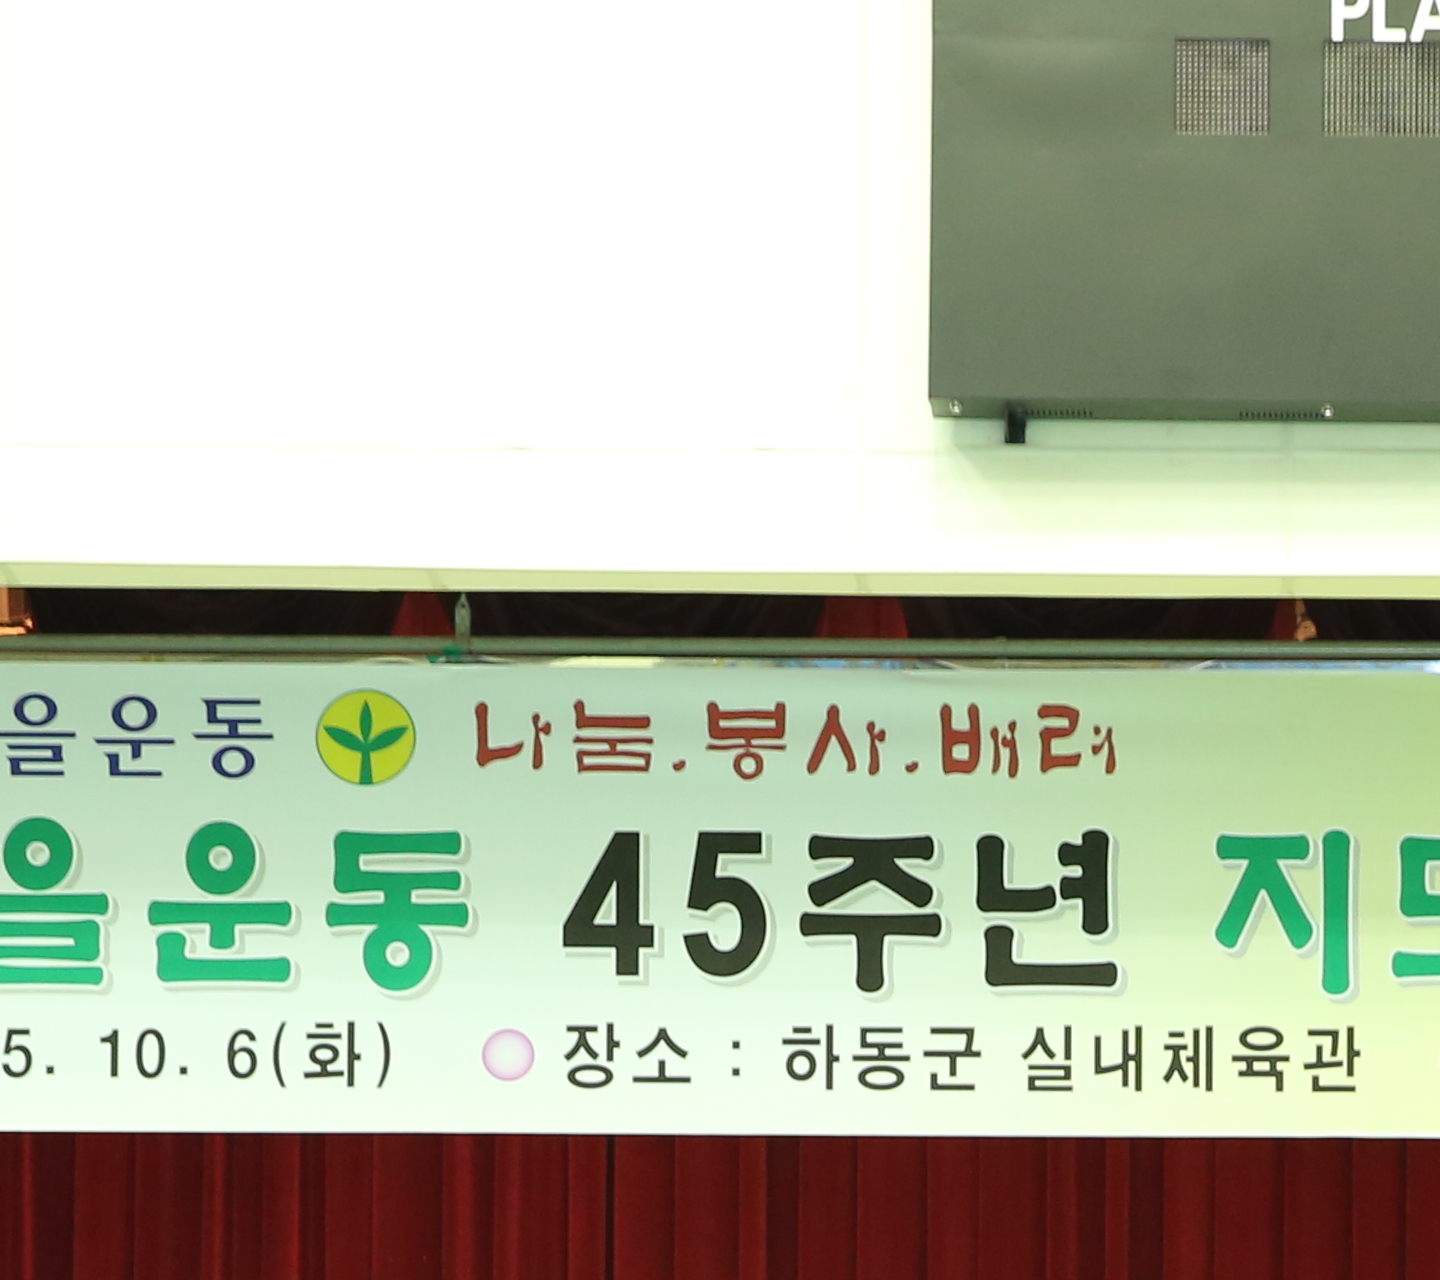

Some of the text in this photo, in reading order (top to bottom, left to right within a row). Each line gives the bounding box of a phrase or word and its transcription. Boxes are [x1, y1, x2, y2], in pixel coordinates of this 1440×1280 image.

[562, 829, 1119, 994] 45주년
[99, 1028, 190, 1082] 10.
[226, 1020, 393, 1090] 6(화)
[563, 1022, 694, 1092] 장소
[781, 1023, 984, 1094] 하동군
[1021, 1025, 1364, 1095] 실내체육관
